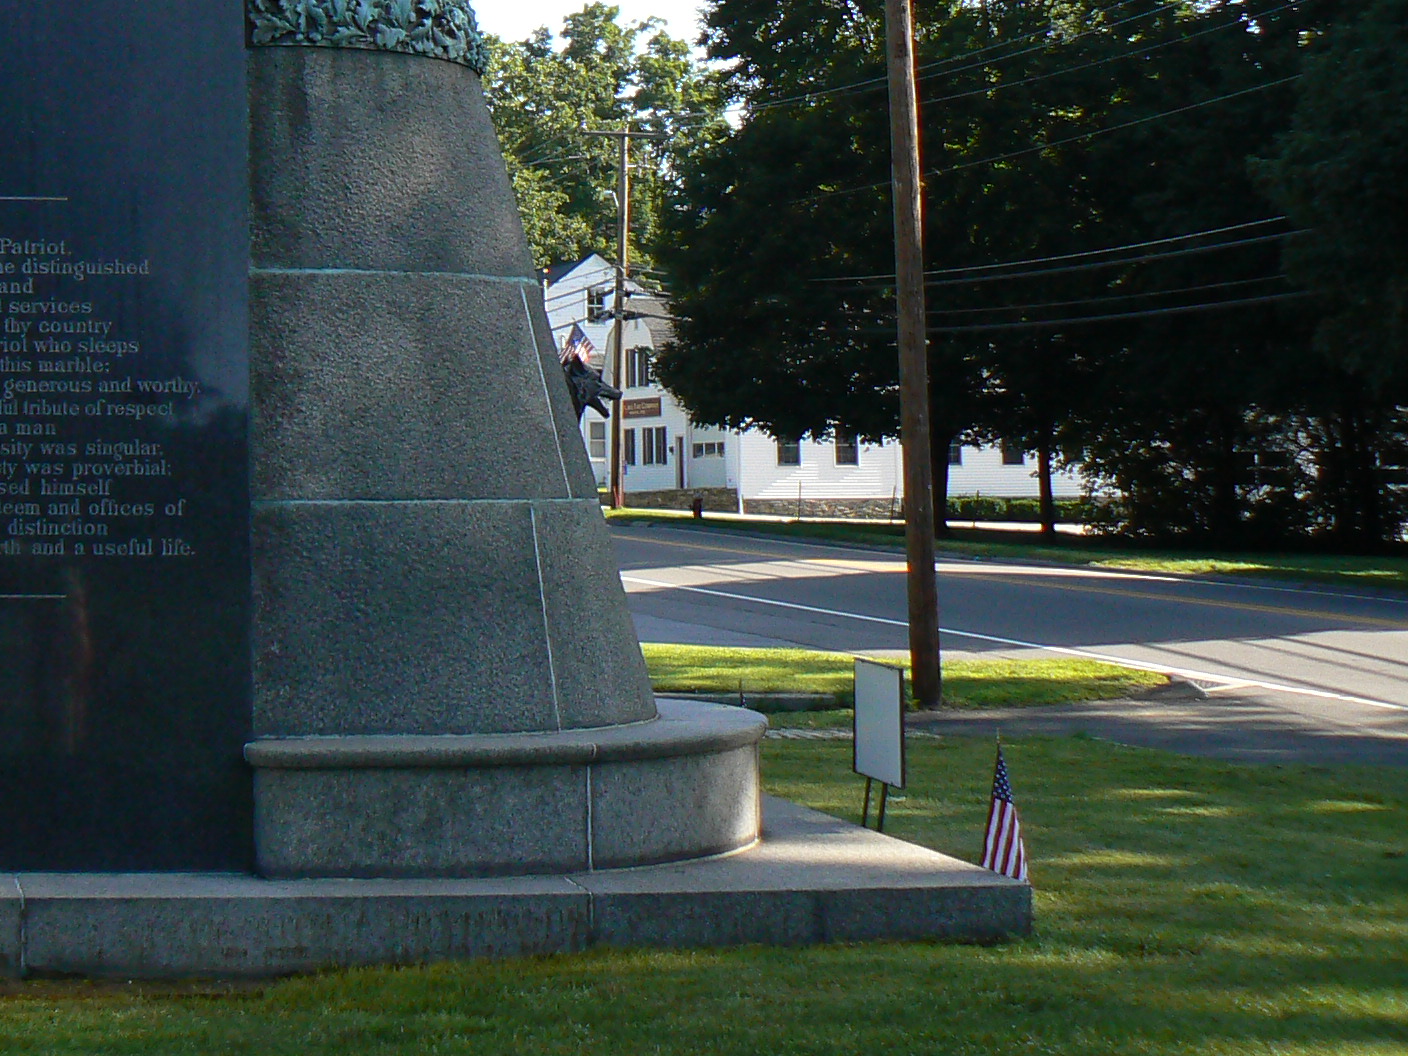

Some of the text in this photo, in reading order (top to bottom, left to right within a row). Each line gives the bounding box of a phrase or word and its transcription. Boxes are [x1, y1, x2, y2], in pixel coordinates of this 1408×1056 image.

[21, 256, 151, 280] distinguished
[8, 296, 93, 313] services
[2, 315, 32, 336] thy
[38, 315, 113, 336] country
[33, 335, 71, 353] who
[77, 335, 141, 356] sleeps
[0, 354, 32, 372] this
[2, 378, 92, 399] generous
[97, 374, 131, 393] and
[22, 397, 80, 416] tribute
[84, 397, 107, 416] of
[106, 397, 175, 419] respect
[15, 422, 57, 435] man
[39, 441, 78, 455] was
[24, 461, 65, 475] was
[40, 477, 113, 495] himself
[47, 497, 80, 516] and
[88, 497, 155, 516] offices
[164, 497, 187, 516] of
[7, 517, 109, 535] distinction
[30, 537, 65, 556] and
[73, 541, 86, 556] a
[92, 537, 154, 556] useful
[160, 537, 196, 556] life.
